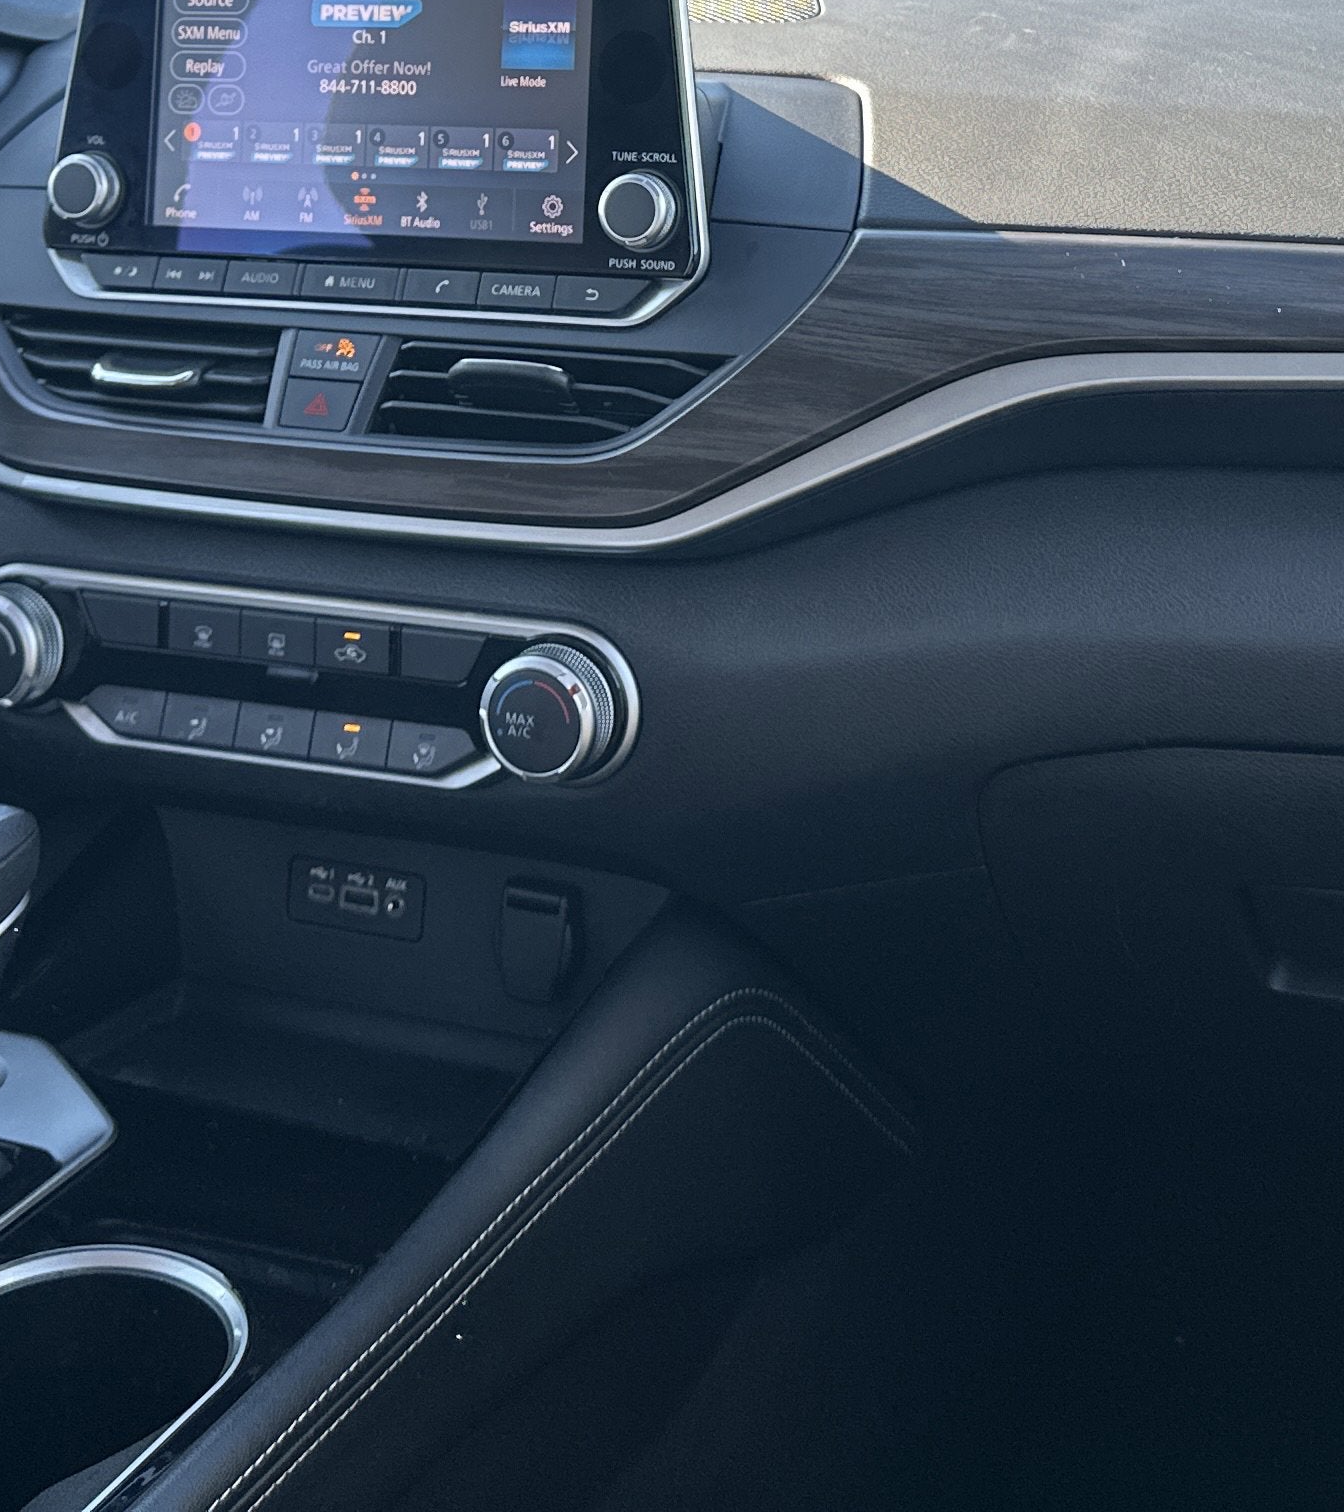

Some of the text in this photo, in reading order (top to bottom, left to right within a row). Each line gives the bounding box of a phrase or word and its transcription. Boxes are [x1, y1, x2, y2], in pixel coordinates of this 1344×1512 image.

[320, 4, 412, 22] PREVIEW
[178, 26, 241, 41] SXM Menu
[185, 59, 226, 76] Replay
[307, 59, 432, 76] Great Offer Now!
[319, 79, 417, 96] 844-711-8800
[500, 75, 547, 89] Live Mode
[87, 135, 105, 146] VOL
[232, 126, 239, 141] 1
[293, 128, 299, 143] 1
[356, 129, 362, 143] 1
[418, 131, 425, 146] 1
[437, 132, 489, 148] 5 1
[502, 135, 555, 150] 6 1
[165, 206, 197, 220] Phone
[243, 210, 260, 221] AM
[344, 213, 383, 226] SiriusXM
[401, 215, 441, 229] BT Audio
[529, 221, 573, 236] Settings
[609, 258, 676, 271] PUSH SOUND
[241, 272, 279, 284] AUDIO
[340, 277, 376, 289] MENU
[491, 283, 541, 297] CAMERA
[299, 358, 360, 372] PASS AIR BAG
[114, 710, 138, 725] A/C
[505, 711, 535, 728] MAX
[507, 724, 531, 739] A/C
